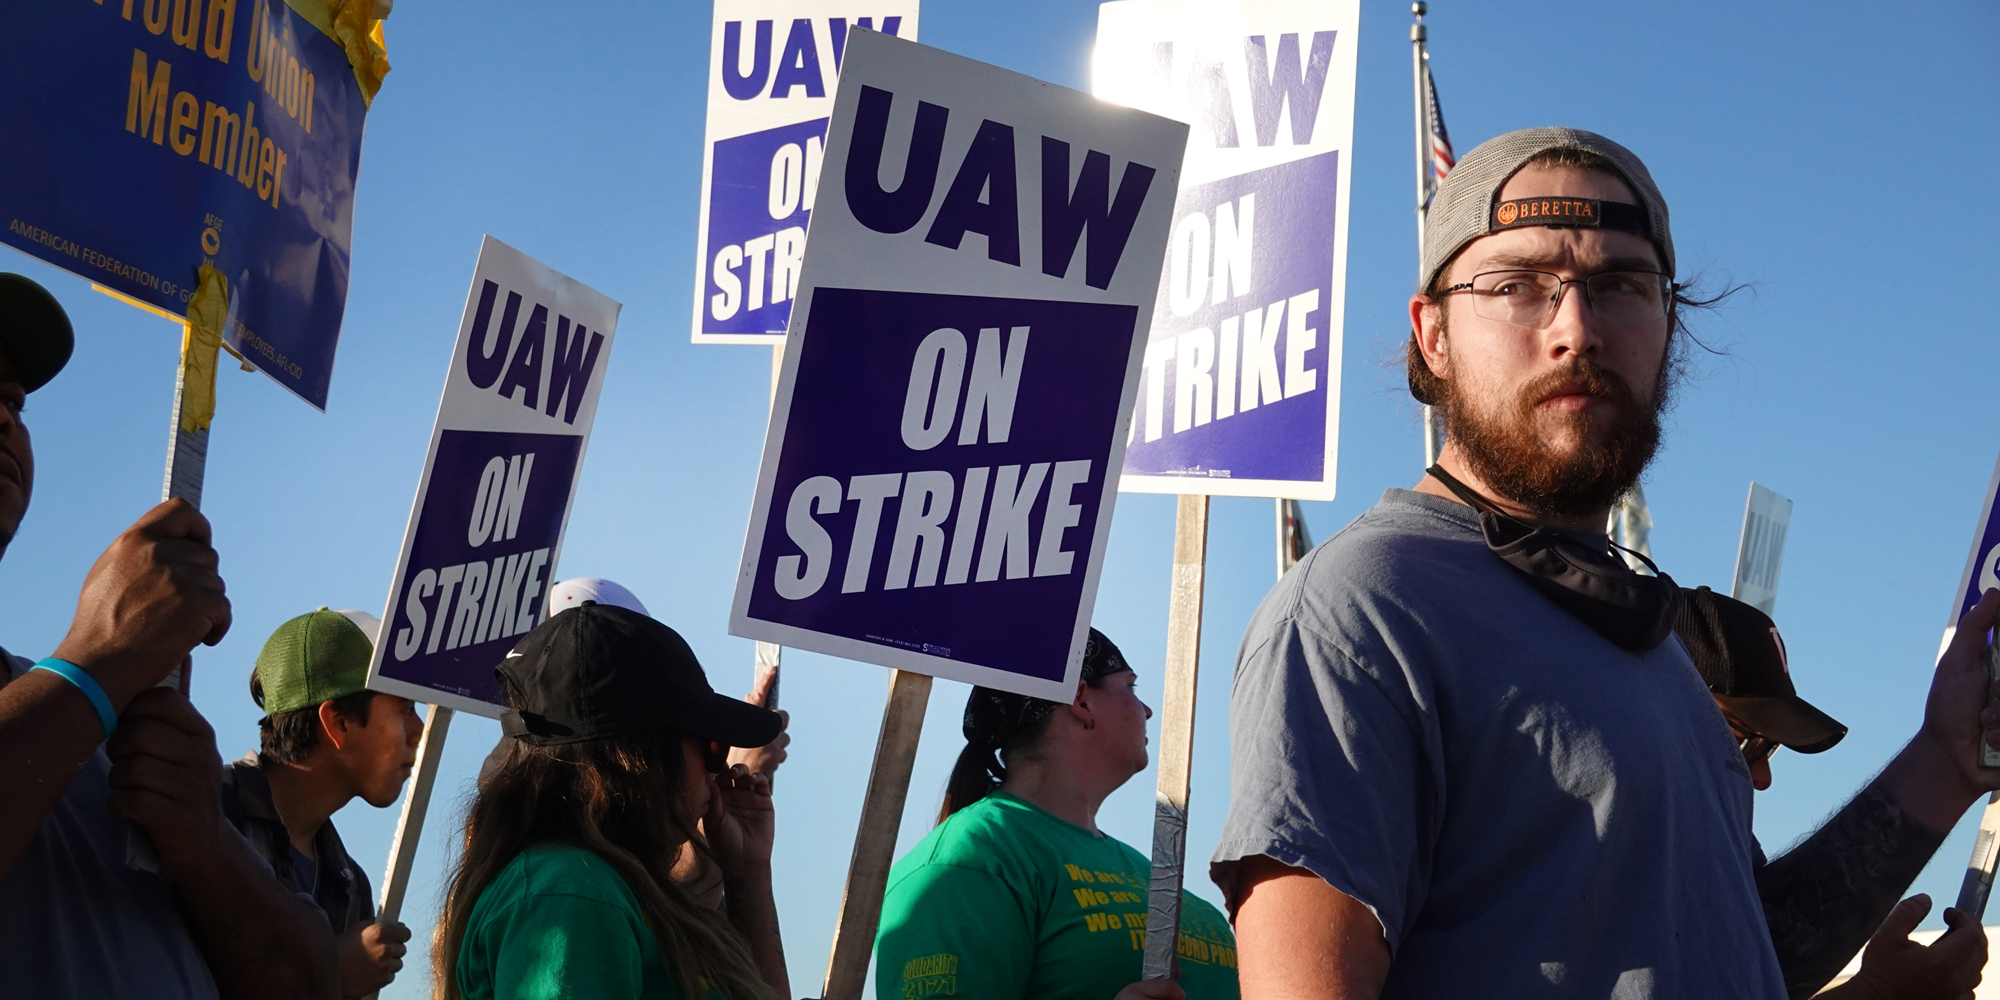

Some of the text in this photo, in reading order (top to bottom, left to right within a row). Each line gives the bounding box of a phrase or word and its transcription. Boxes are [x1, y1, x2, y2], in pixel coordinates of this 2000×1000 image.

[94, 0, 315, 134] oud Union
[1150, 30, 1338, 148] AW
[125, 47, 287, 209] Member
[844, 84, 1156, 290] UAW
[204, 212, 224, 232] AFGE
[1168, 193, 1255, 318] ON
[1520, 201, 1593, 218] BERETTA
[10, 219, 303, 379] AMERICAN FEDERATION OF EMPLOYEES, AFL-CIO
[711, 226, 806, 321] STR
[467, 279, 605, 425] UAW
[900, 326, 1031, 450] ON
[1126, 289, 1319, 448] TRIKE
[468, 453, 535, 548] ON
[774, 459, 1092, 601] STRIKE
[1742, 511, 1787, 591] UAW
[394, 547, 550, 662] STRIKE
[1064, 864, 1095, 883] We
[1094, 871, 1124, 884] are
[1073, 888, 1142, 908] We are
[1084, 912, 1122, 932] We
